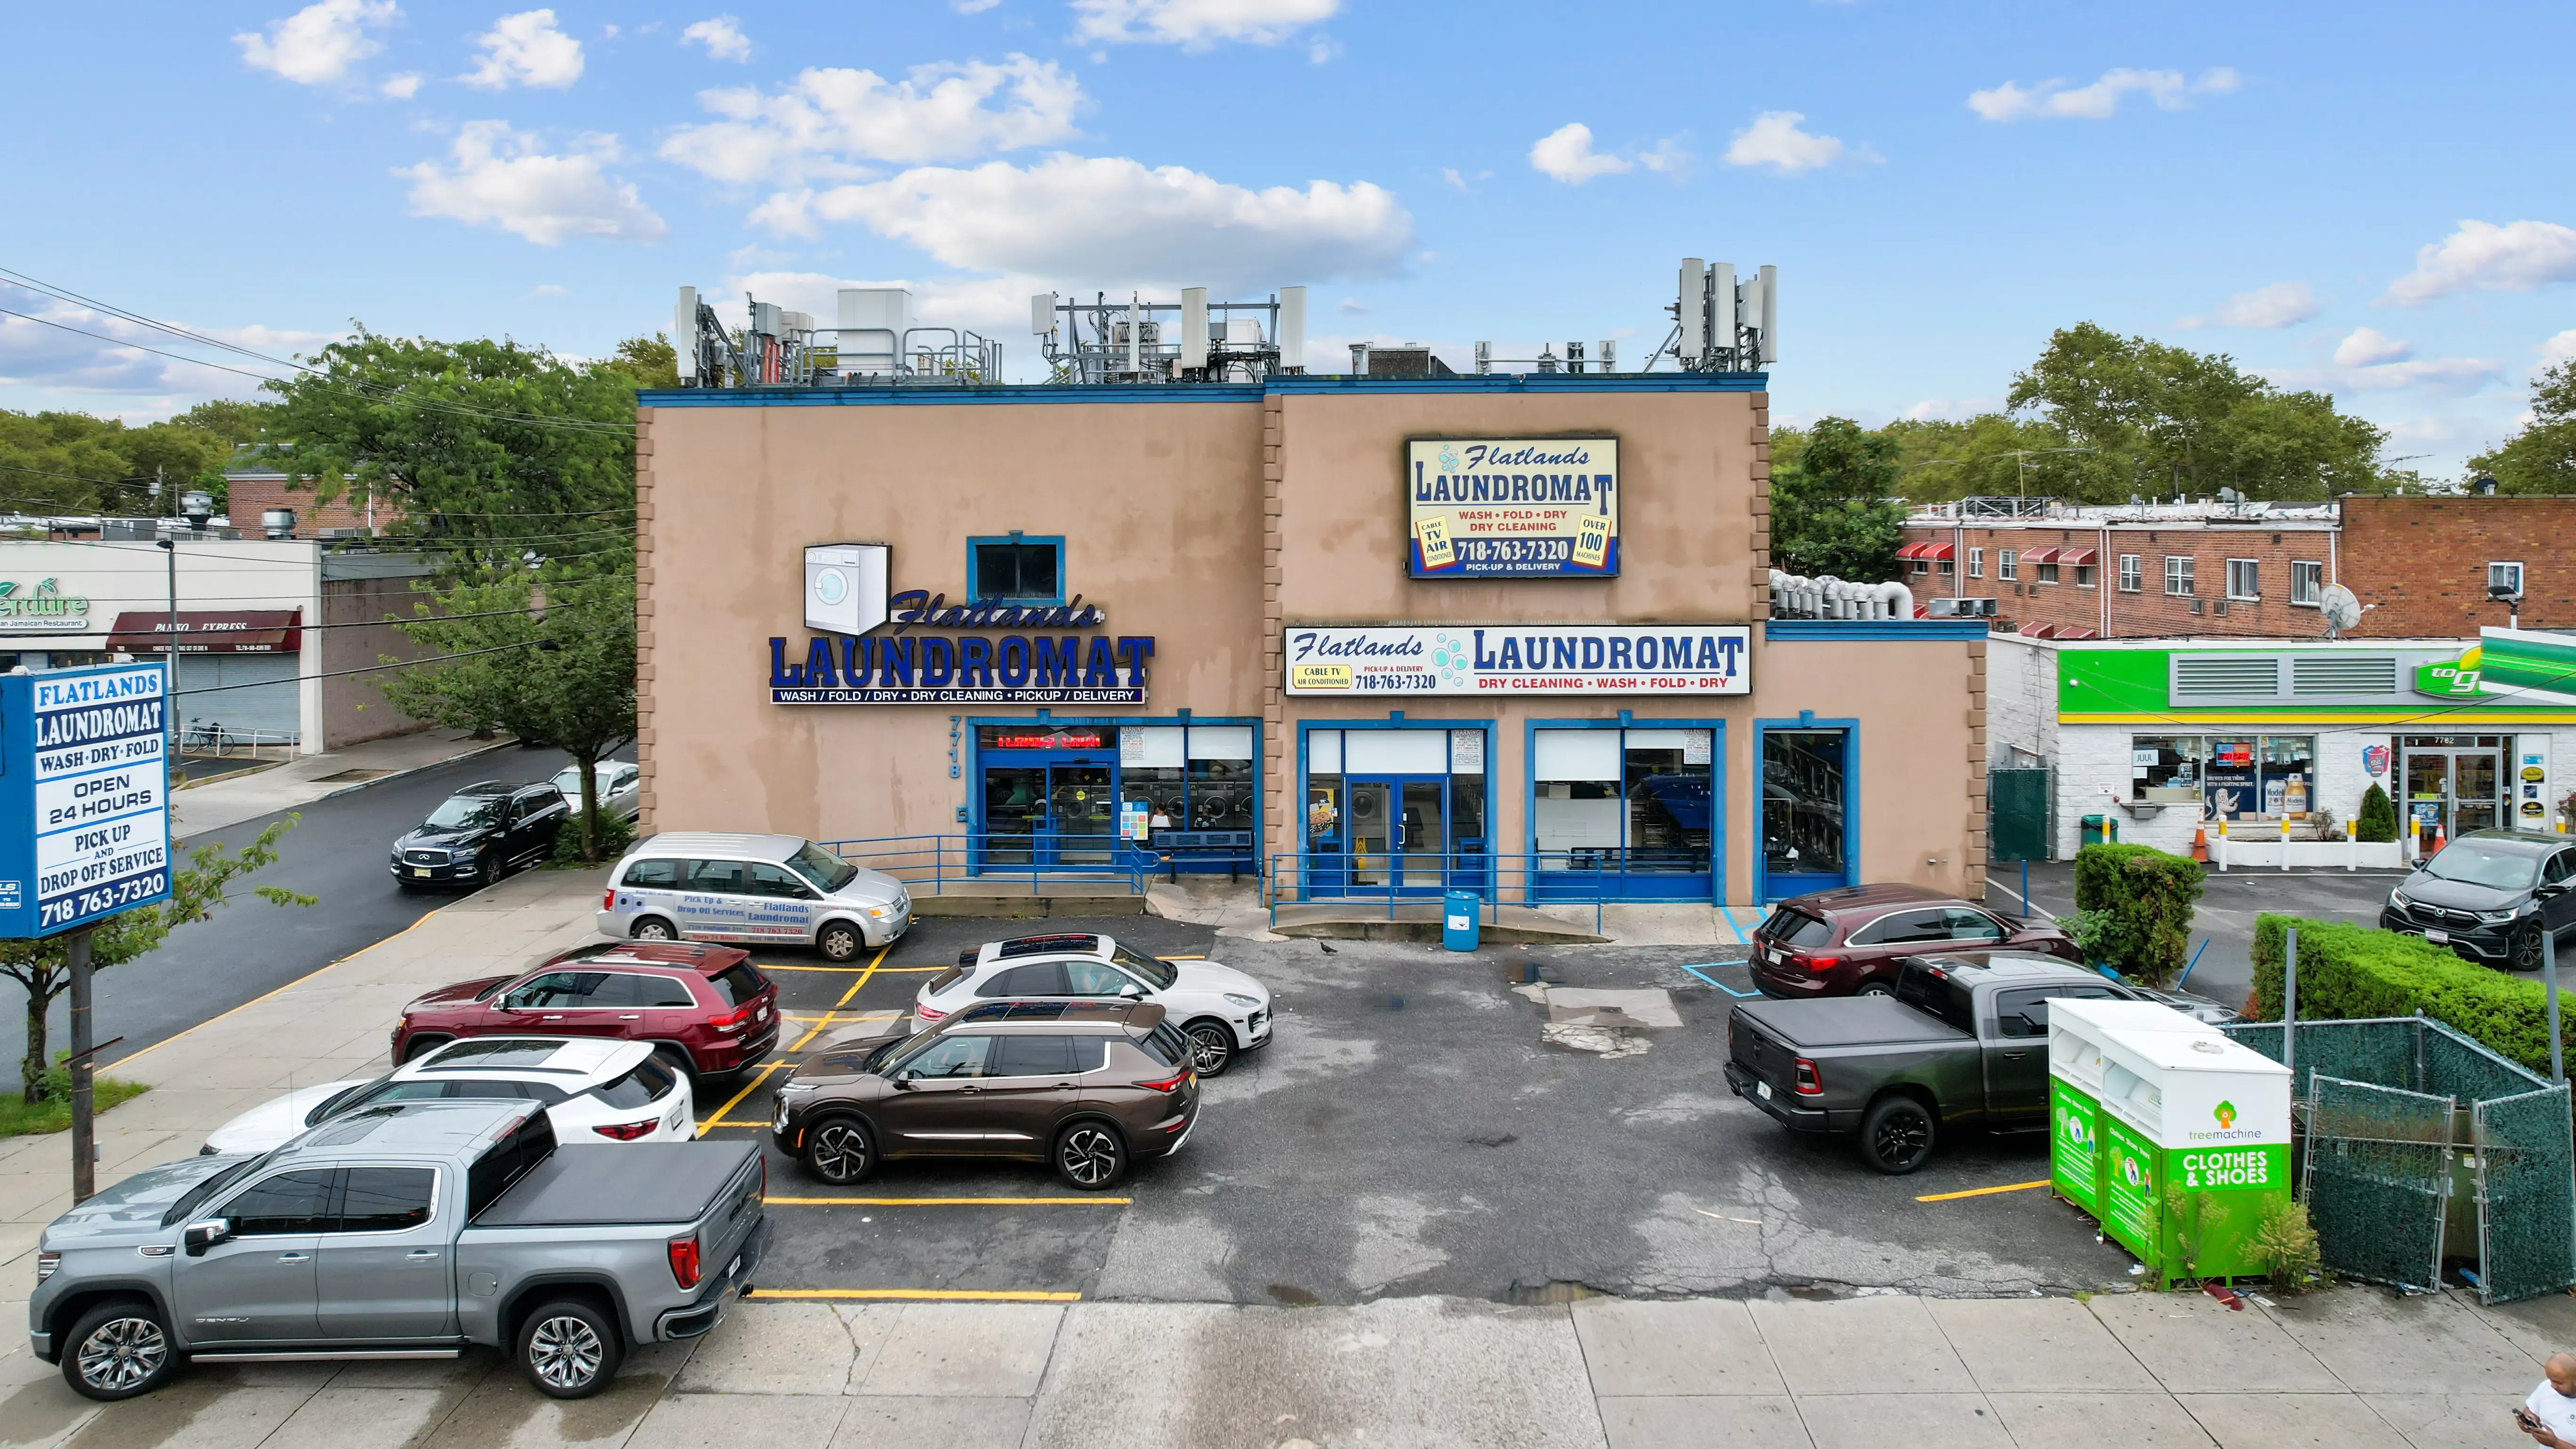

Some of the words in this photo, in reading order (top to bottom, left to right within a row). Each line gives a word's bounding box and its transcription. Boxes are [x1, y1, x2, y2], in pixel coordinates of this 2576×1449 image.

[1465, 445, 1590, 470] Flatlands
[1416, 461, 1612, 515] LAUNDROMAT
[1459, 511, 1492, 519] WASH
[1503, 511, 1533, 519] FOLD
[1421, 521, 1442, 531] CABLE
[1497, 523, 1556, 531] CLEANING
[1583, 519, 1606, 531] OVER
[1425, 530, 1441, 541] TV
[1579, 531, 1602, 551] 100
[1426, 541, 1448, 554] AIR
[1458, 541, 1568, 561] 718-763-7320
[1577, 551, 1601, 561] MACHINES
[1427, 551, 1452, 562] CONDITIONED
[890, 589, 1101, 635] Flatlands
[1293, 633, 1423, 661] Flatlands
[1473, 630, 1743, 676] LAUNDROMAT
[769, 636, 1155, 689] LAUNDROMAT
[1304, 668, 1328, 676] CABLE
[1331, 668, 1341, 676] TV
[39, 674, 157, 706] FLATLANDS
[1355, 675, 1436, 689] 718-763-7320
[1479, 678, 1506, 689] DRY
[1512, 678, 1583, 688] CLEANING
[1597, 678, 1636, 688] WASH
[1650, 678, 1686, 688] FOLD
[1699, 678, 1728, 688] DRY
[2449, 672, 2480, 692] g
[780, 691, 816, 701] WASH
[829, 691, 861, 701] FOLD
[874, 691, 899, 701] DRY
[911, 691, 937, 701] DRY
[940, 691, 1003, 701] CLEANING
[1015, 691, 1062, 701] PICKUP
[1073, 691, 1133, 701] DELIVERY
[36, 701, 161, 747] LAUNDROMAT
[40, 751, 84, 772] WASH
[91, 745, 120, 764] DRY
[126, 739, 159, 757] FOLD
[74, 774, 130, 798] OPEN
[2267, 788, 2284, 796] Model
[50, 805, 77, 824] 24
[82, 790, 152, 817] HOURS
[75, 829, 109, 852] PICK
[113, 824, 131, 843] UP
[94, 847, 114, 860] AND
[40, 869, 78, 894] DROP
[81, 862, 107, 883] OFF
[109, 847, 163, 875] SERVICE
[41, 899, 74, 927] 718
[79, 873, 164, 916] 763-7320
[684, 895, 701, 904] Pick
[705, 896, 714, 904] Up
[764, 902, 809, 913] Flatlands
[677, 905, 696, 914] Drop
[713, 908, 744, 917] Services
[748, 912, 808, 924] Laundromat
[2189, 1128, 2262, 1140] treemachine
[2183, 1151, 2267, 1171] CLOTHES
[2186, 1172, 2199, 1187] &
[2205, 1167, 2268, 1186] SHOES
